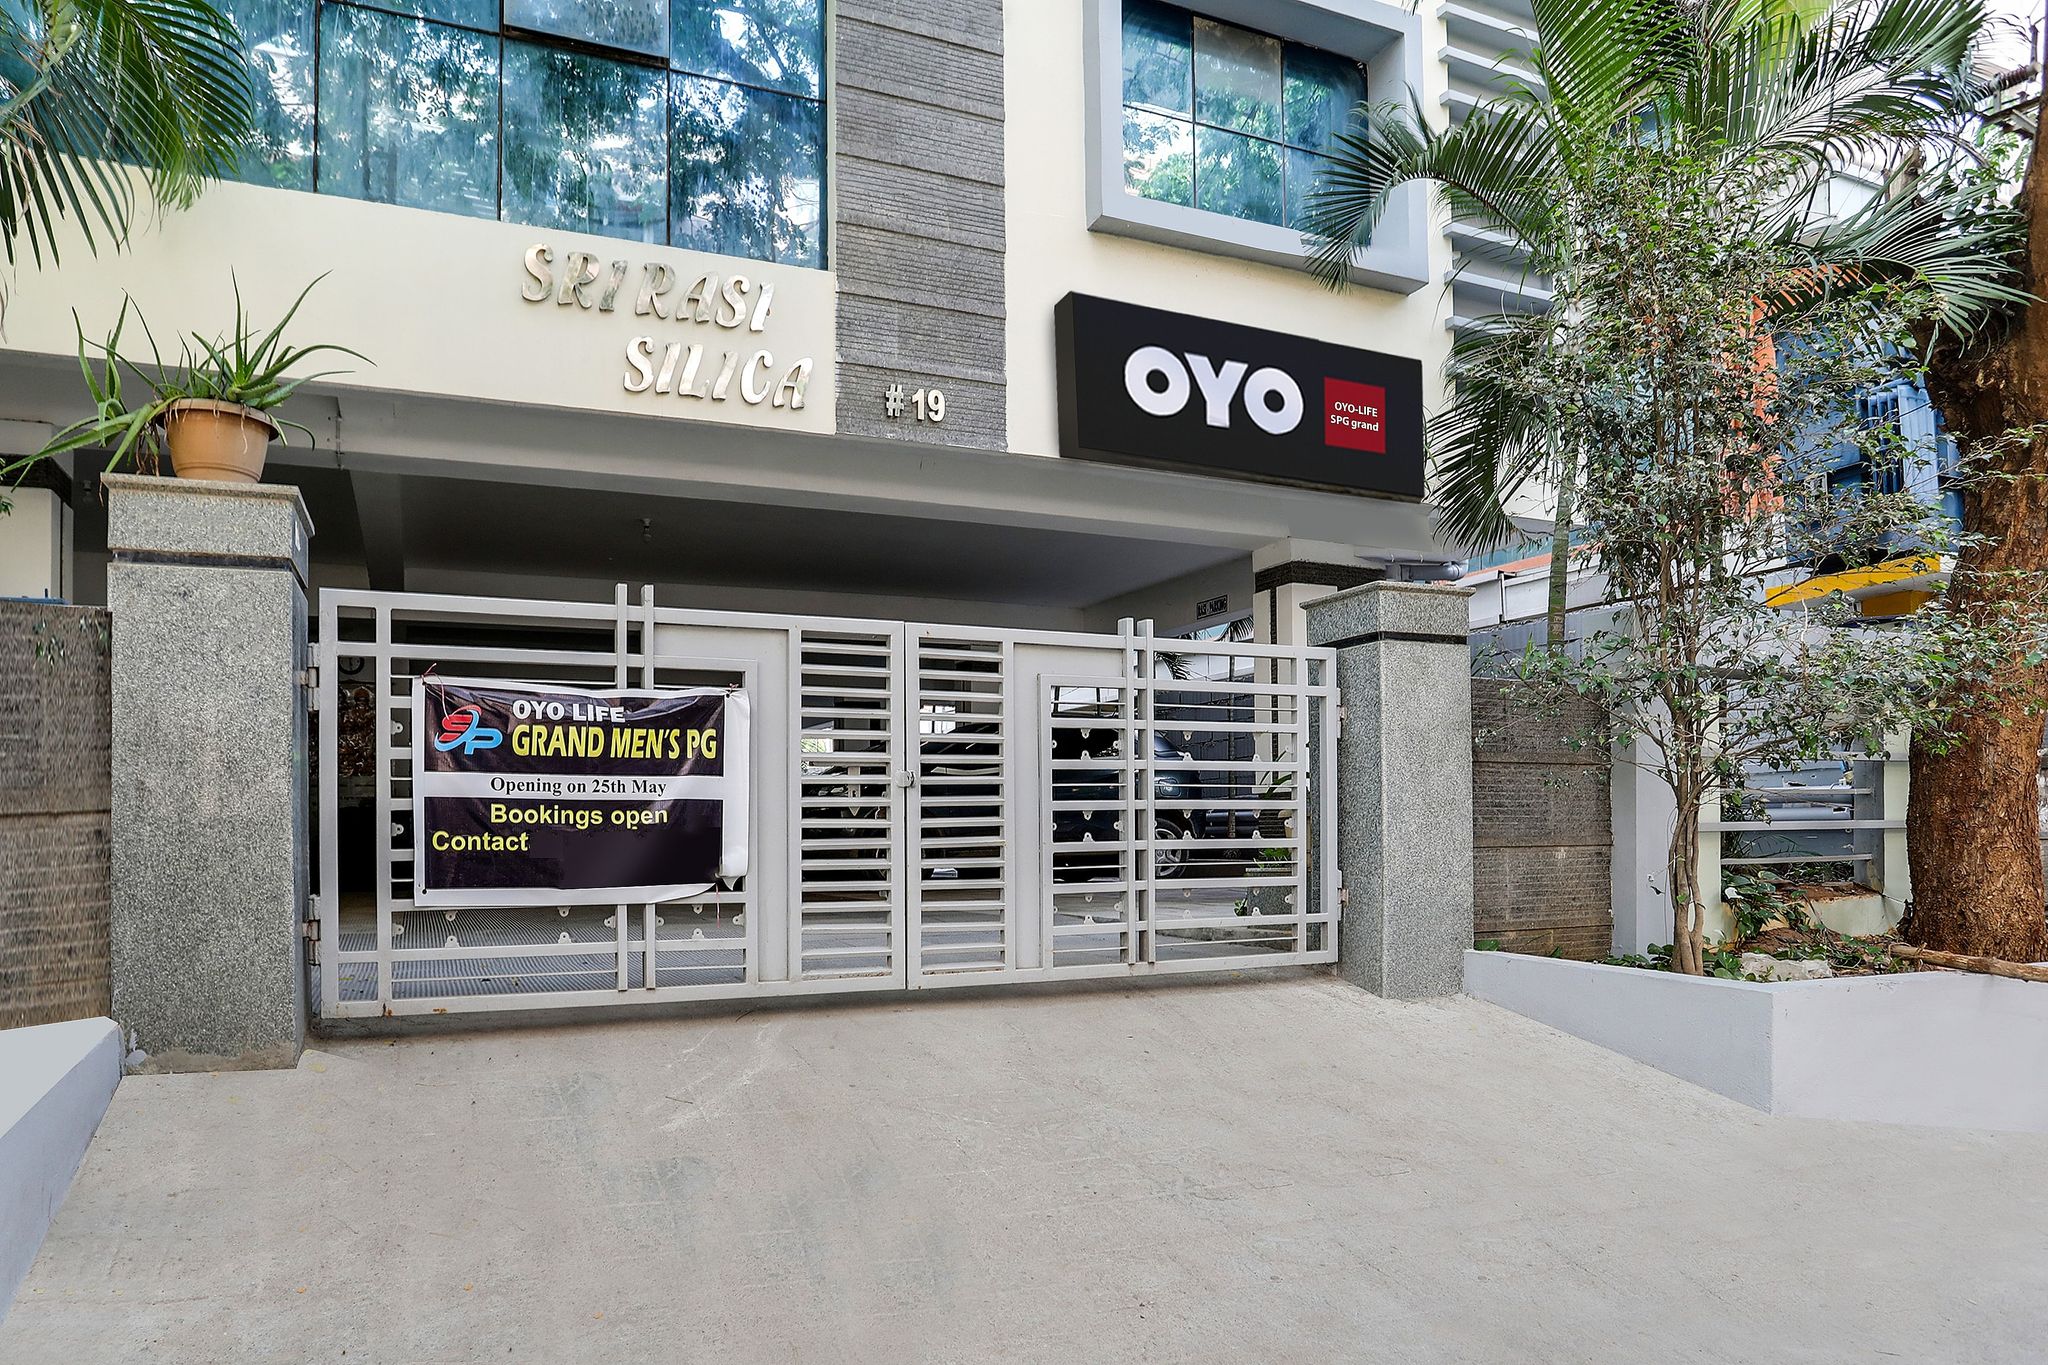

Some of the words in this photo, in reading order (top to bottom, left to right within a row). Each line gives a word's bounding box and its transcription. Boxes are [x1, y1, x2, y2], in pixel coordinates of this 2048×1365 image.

[521, 243, 628, 313] SRI
[635, 261, 776, 332] RASI
[623, 335, 814, 409] SILICA
[1124, 345, 1304, 435] OYO
[1334, 401, 1379, 418] OYO-LIFE
[1330, 414, 1350, 427] SPG
[1350, 418, 1379, 433] grand
[511, 699, 565, 721] OYO
[573, 703, 627, 723] LIFE
[511, 723, 605, 758] GRAND
[610, 727, 681, 760] MEN'S
[686, 728, 718, 760] PG
[490, 776, 562, 796] Opening
[567, 781, 587, 794] on
[591, 779, 628, 794] 25th
[631, 779, 667, 797] May
[490, 803, 604, 830] Bookings
[610, 807, 669, 830] open
[431, 830, 530, 852] Contact
